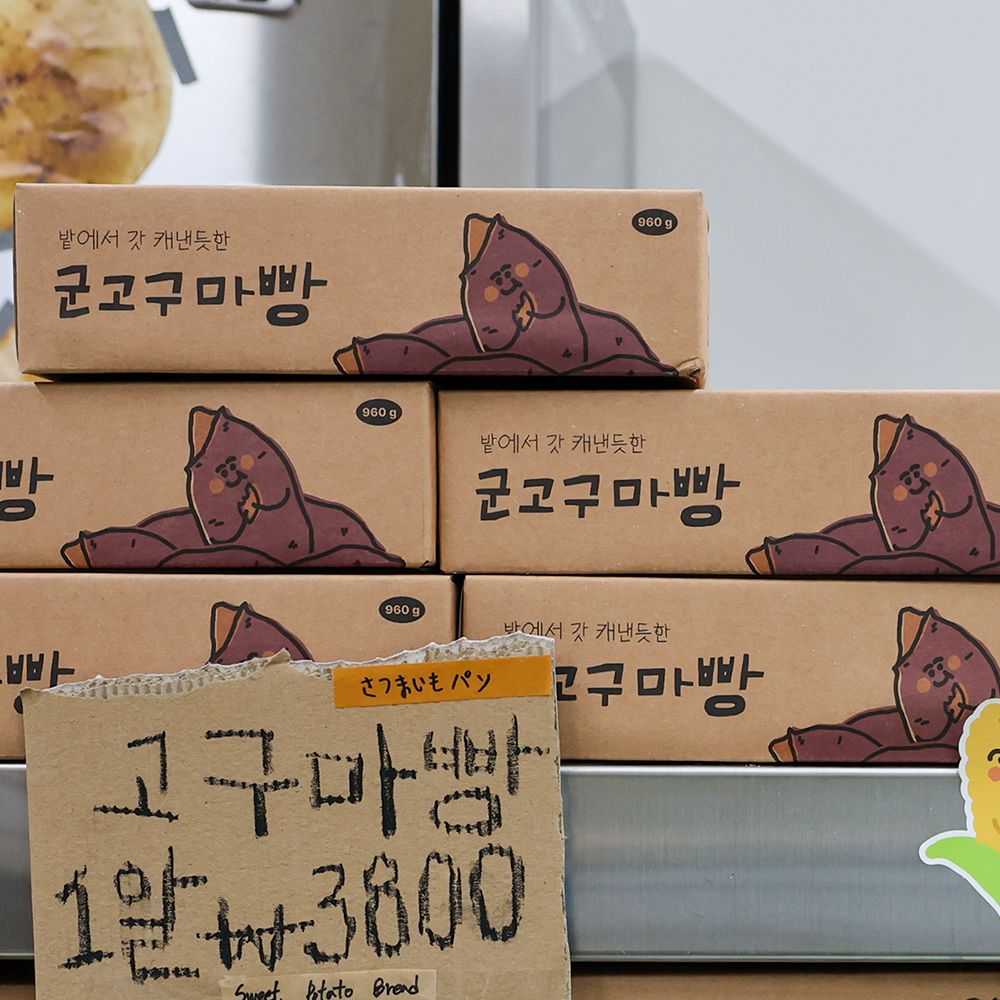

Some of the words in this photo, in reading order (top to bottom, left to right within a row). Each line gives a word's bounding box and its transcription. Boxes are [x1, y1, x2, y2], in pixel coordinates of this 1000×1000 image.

[637, 217, 662, 227] 960
[665, 219, 673, 230] g
[58, 229, 120, 251] 밭에서
[127, 229, 147, 251] 갓
[153, 229, 231, 251] 캐낸듯한
[54, 262, 328, 327] 군고구마빵
[362, 407, 386, 417] 960
[388, 409, 397, 420] g
[480, 432, 539, 454] 밭에서
[547, 433, 564, 454] 갓
[571, 432, 647, 454] 캐낸듯한
[475, 463, 741, 527] 군고구마빵
[385, 604, 409, 614] 960
[412, 605, 420, 617] g
[571, 622, 589, 642] 갓
[595, 621, 670, 643] 캐낸듯한
[555, 653, 764, 717] 고구마빵
[93, 713, 549, 838] 고구마빵
[373, 974, 419, 999] Bread
